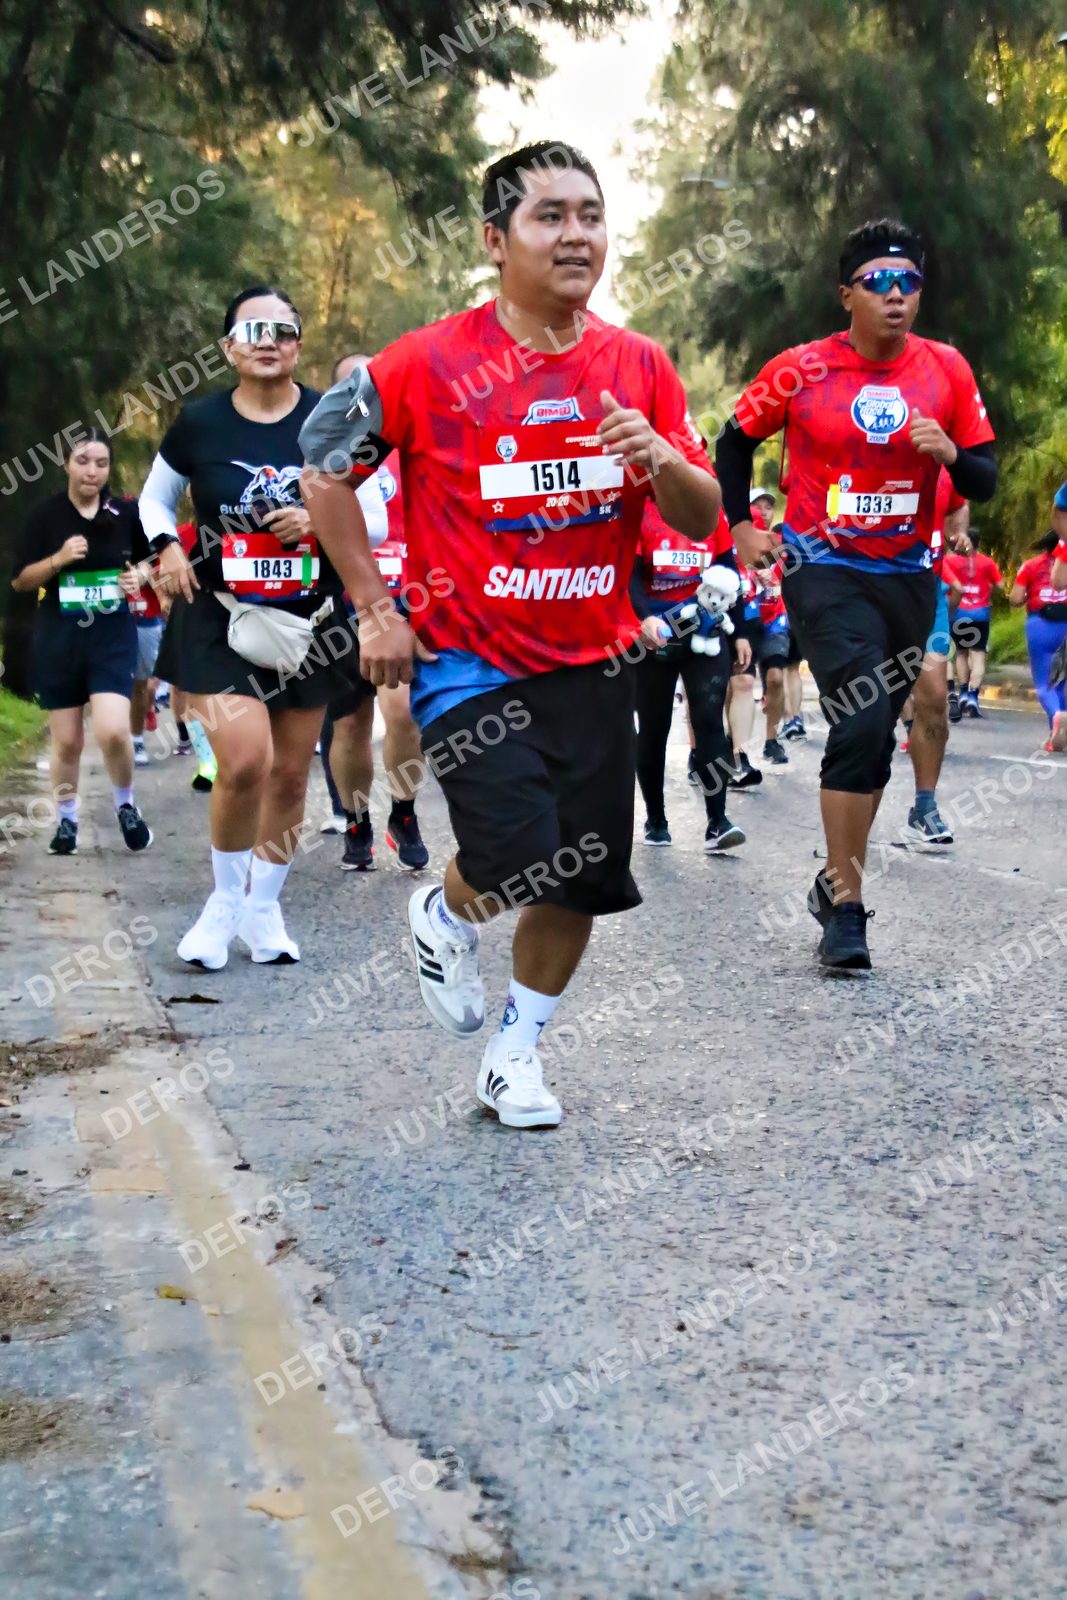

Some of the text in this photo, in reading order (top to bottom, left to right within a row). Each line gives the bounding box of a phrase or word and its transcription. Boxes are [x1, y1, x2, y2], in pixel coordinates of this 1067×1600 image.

[530, 461, 581, 492] 1514
[855, 495, 893, 514] 1333
[671, 552, 698, 565] 2355
[253, 559, 292, 579] 1843
[483, 564, 615, 600] SANTIAGO
[84, 588, 103, 601] 221
